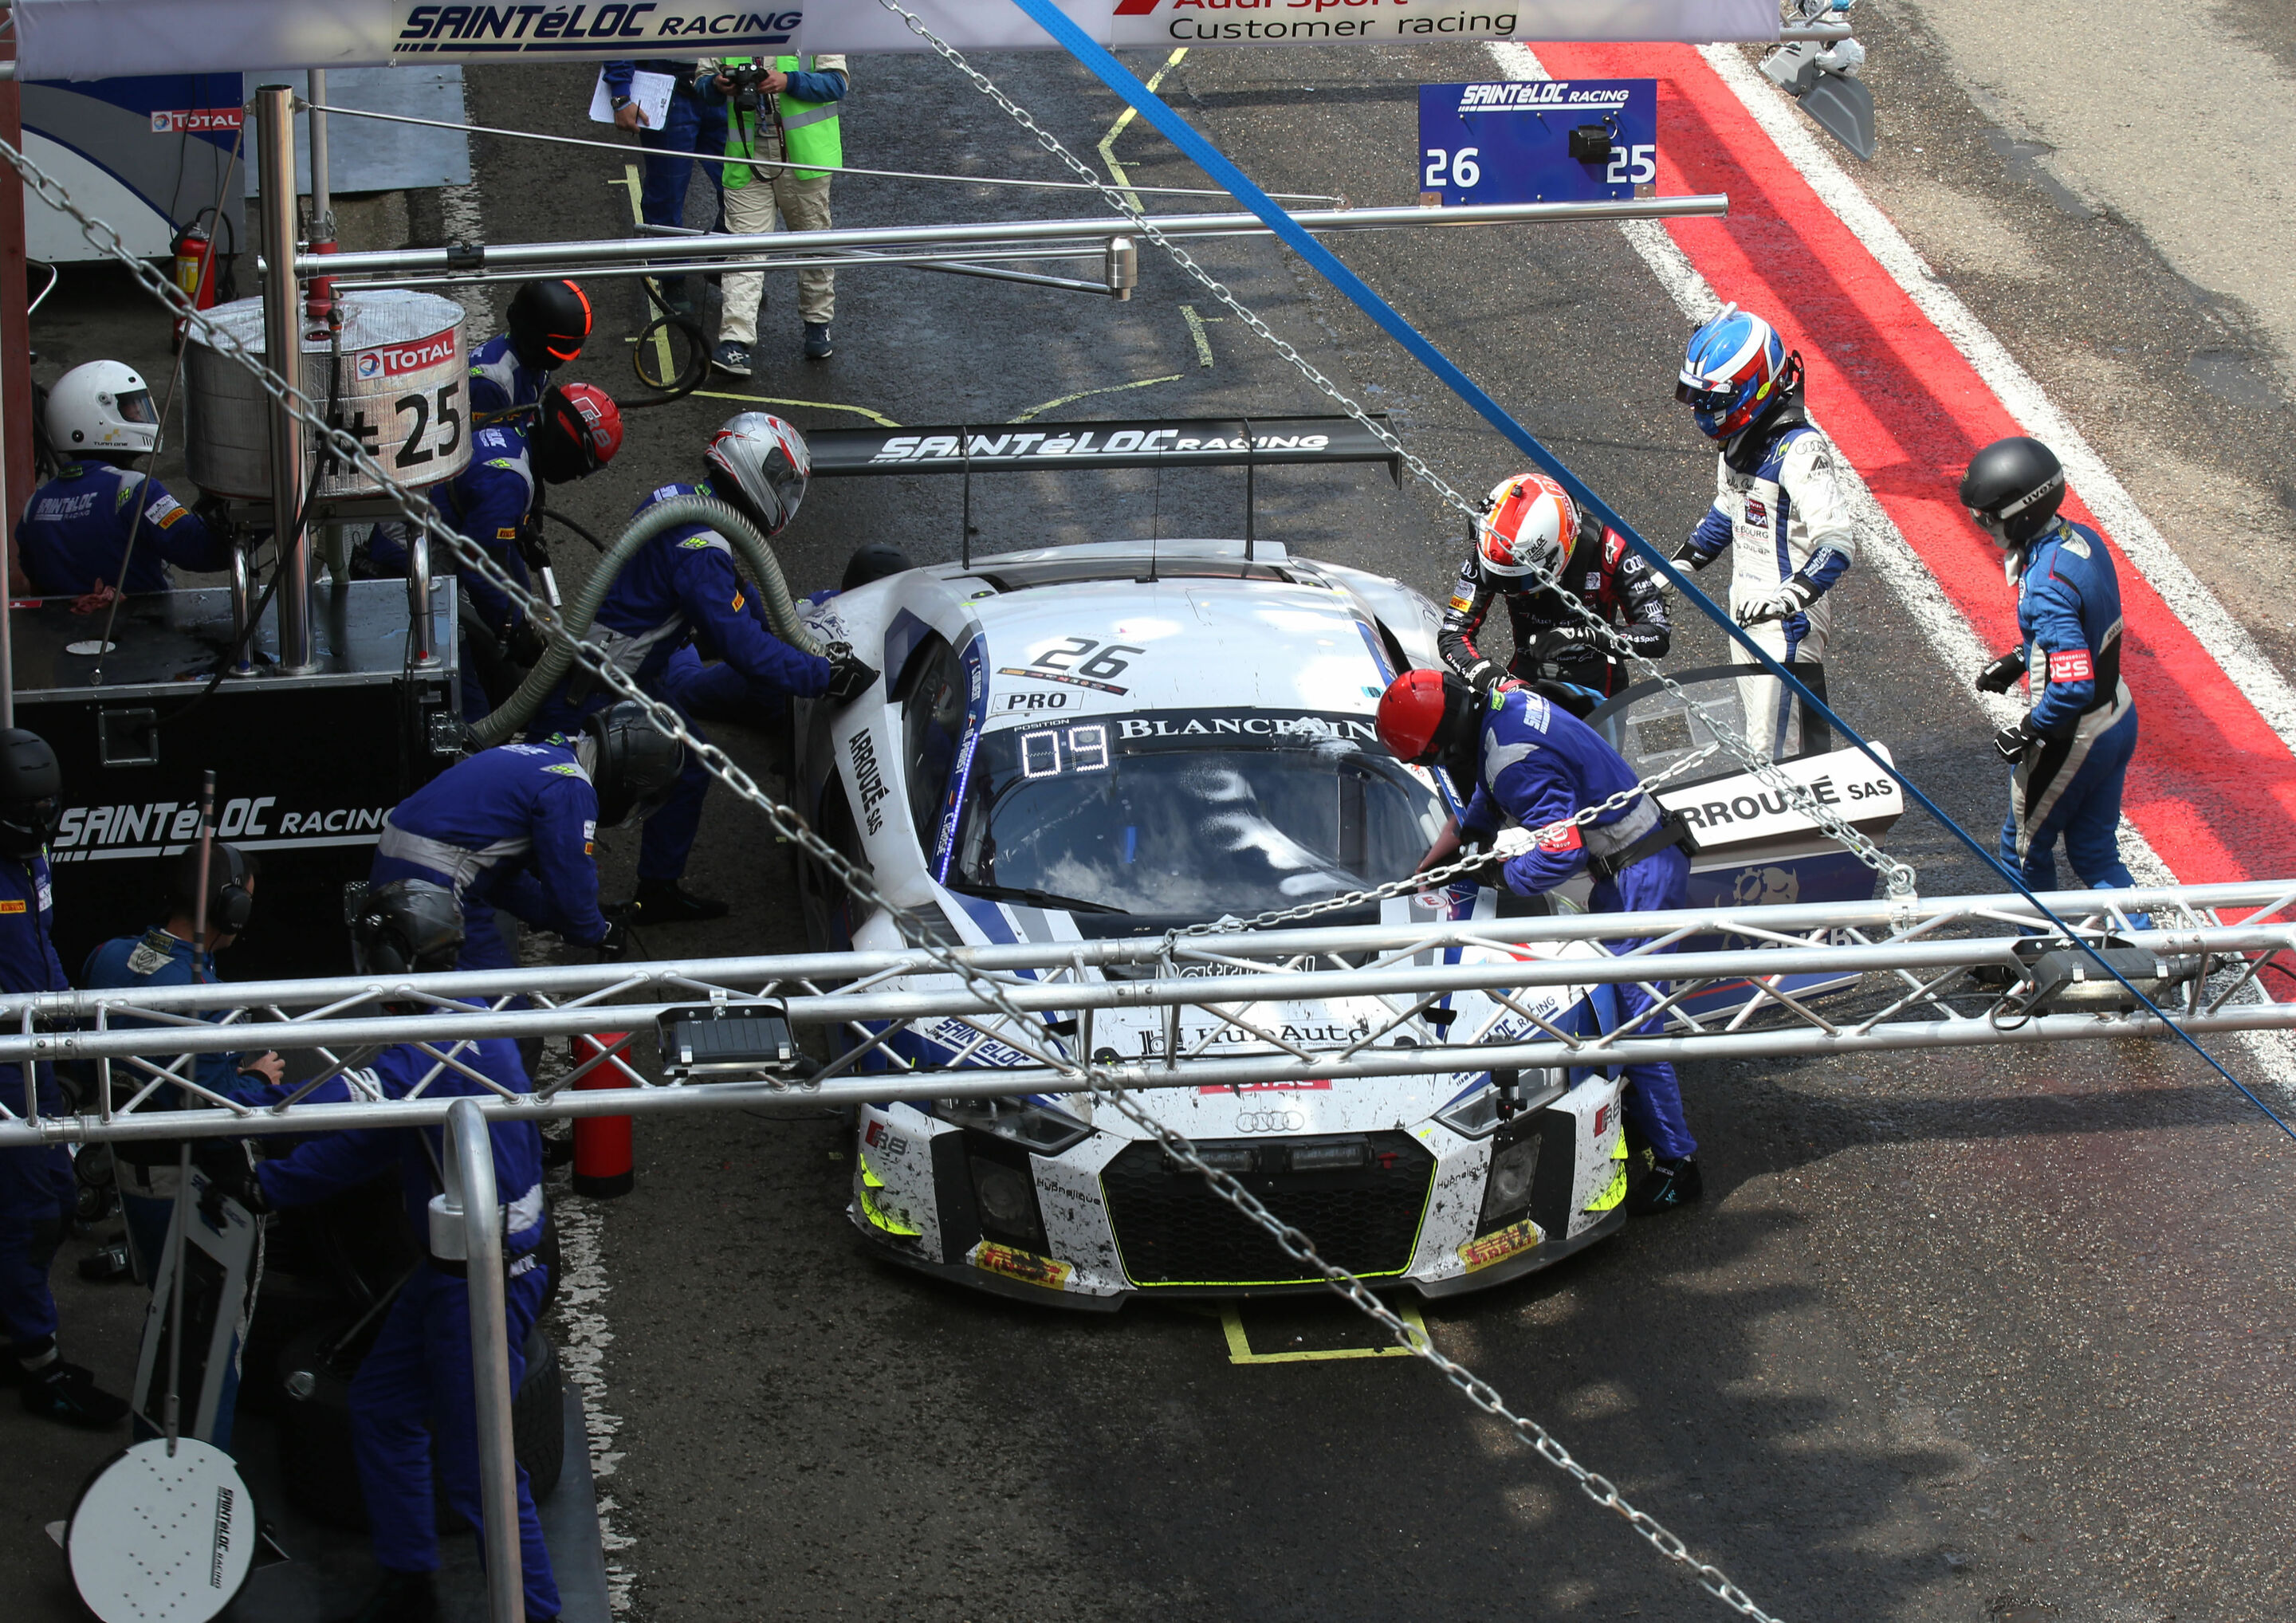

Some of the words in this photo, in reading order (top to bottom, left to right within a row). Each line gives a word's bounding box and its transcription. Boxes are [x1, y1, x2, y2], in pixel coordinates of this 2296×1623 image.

[399, 2, 658, 38] SAINTéLOC
[658, 11, 803, 36] RACING
[1169, 18, 1376, 39] Customer
[1398, 13, 1517, 35] racing
[1461, 83, 1569, 104] SAINTéLOC
[1568, 90, 1629, 102] RACING
[172, 114, 241, 128] TOTAL
[1426, 147, 1480, 187] 26
[1606, 144, 1656, 183] 25
[384, 340, 452, 370] TOTAL
[395, 380, 460, 469] 25
[874, 429, 1179, 458] SAINTéLOC
[1175, 434, 1331, 452] RACING
[1030, 637, 1147, 679] 26
[1007, 693, 1067, 709] PRO
[1013, 718, 1070, 732] POSITION
[1020, 725, 1109, 778] 09
[848, 727, 890, 814] ARROUZÉ
[1674, 775, 1841, 829] RROUÉ
[1847, 779, 1893, 800] SAS
[866, 808, 883, 836] SAS
[1280, 1024, 1371, 1041] Auto
[1602, 1098, 1620, 1130] R8
[872, 1129, 909, 1156] R8
